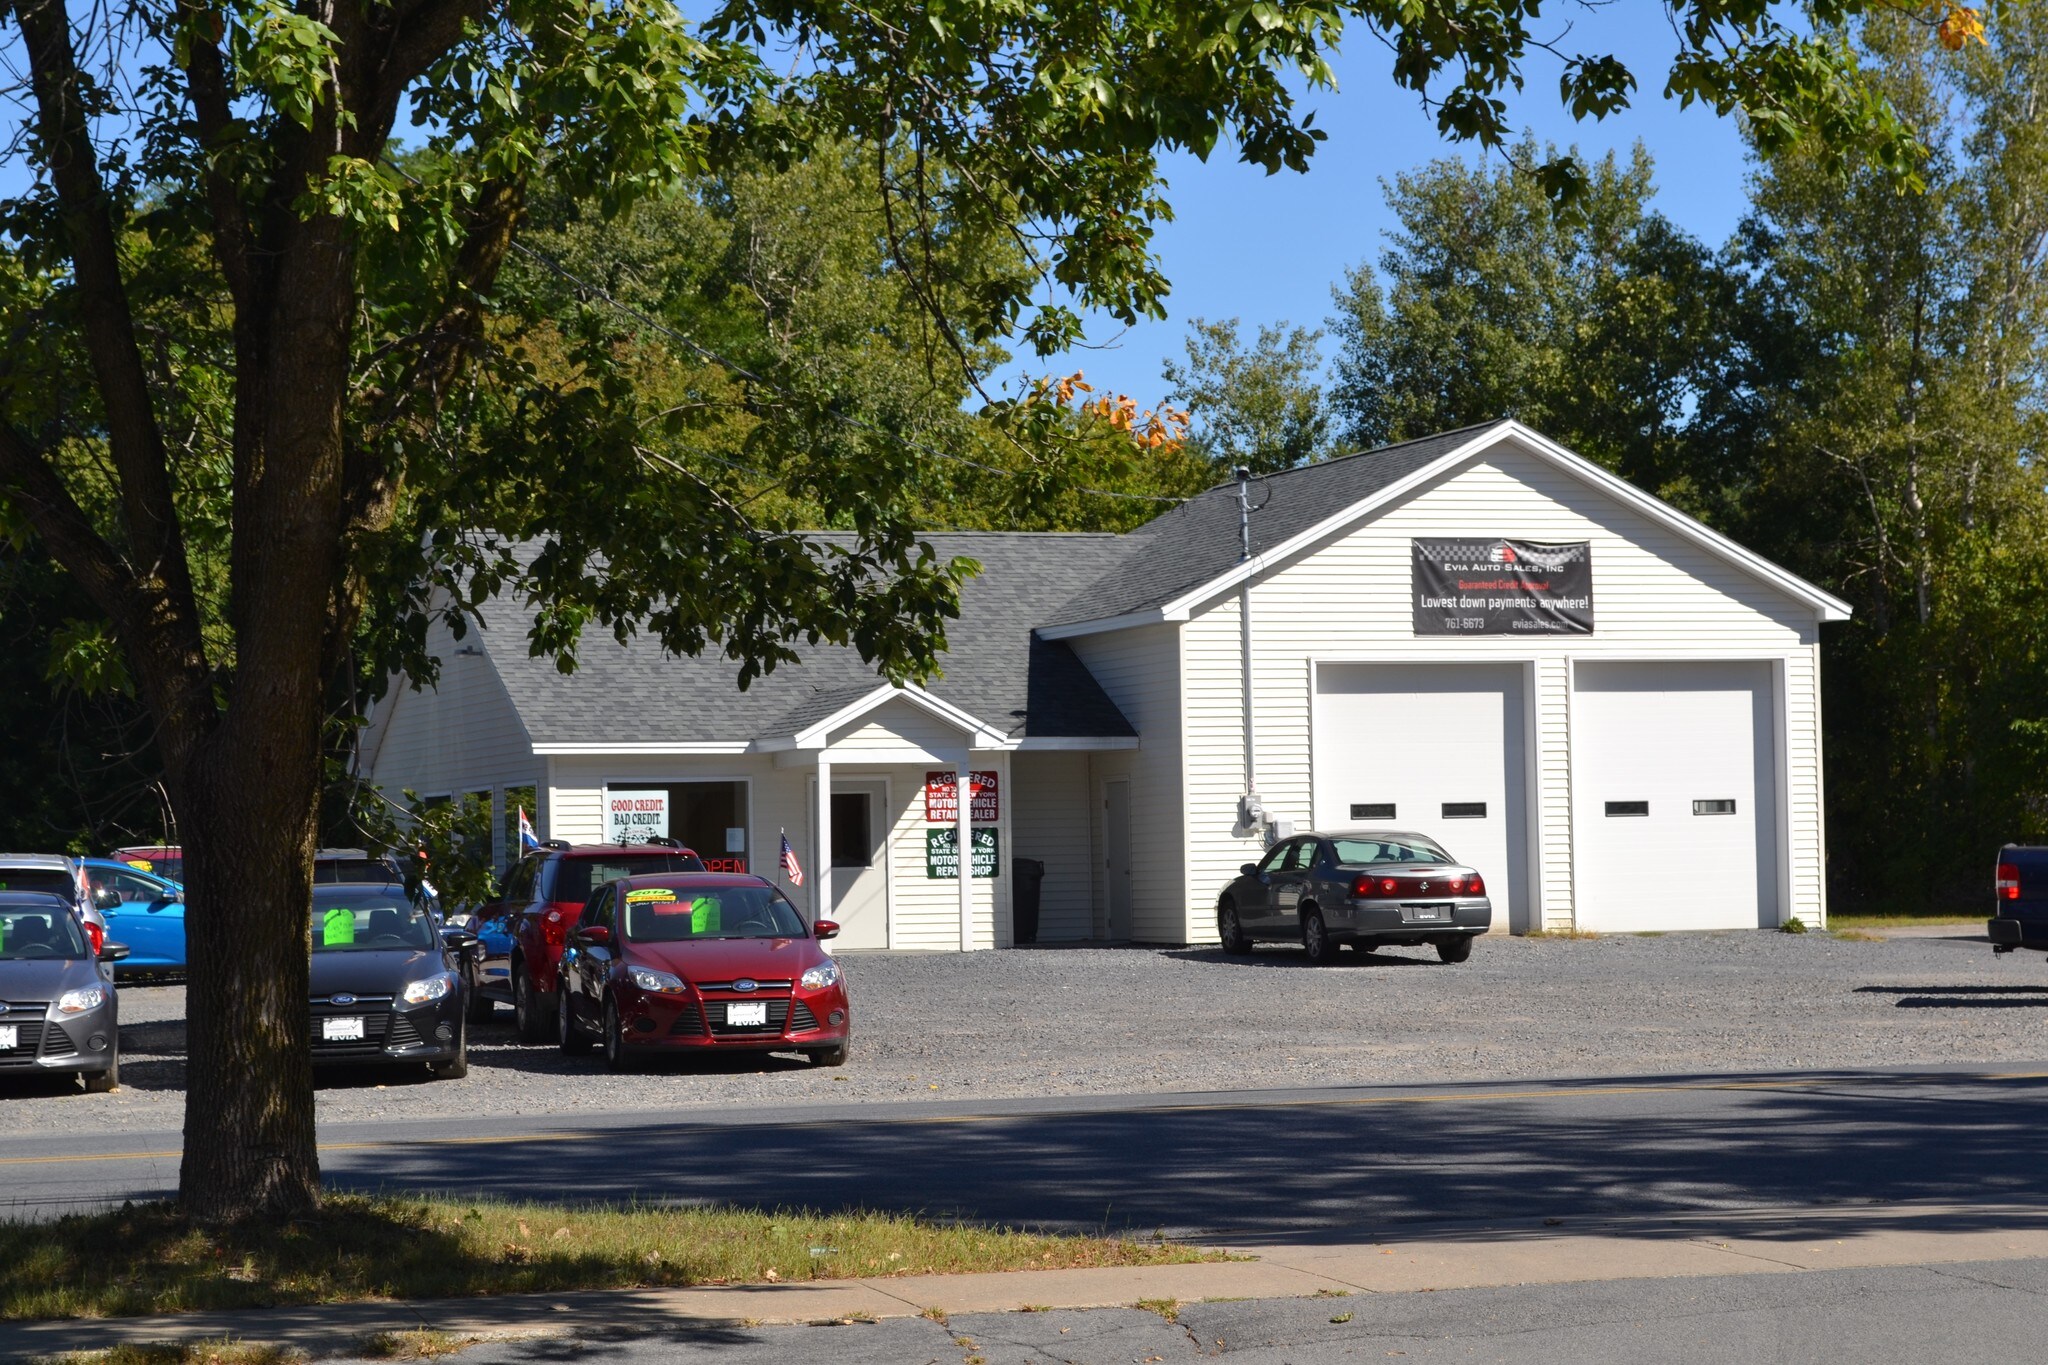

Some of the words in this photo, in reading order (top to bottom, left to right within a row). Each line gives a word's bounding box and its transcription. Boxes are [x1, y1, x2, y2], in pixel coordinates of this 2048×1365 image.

[1458, 580, 1498, 590] Guaranteed
[1498, 580, 1519, 590] Credit
[1421, 594, 1457, 608] Lowest
[1460, 594, 1486, 608] down
[1488, 595, 1537, 610] payments
[1540, 595, 1589, 611] anywhere!
[1445, 618, 1485, 629] 761-6673
[1512, 618, 1569, 629] eviasales.com
[929, 772, 996, 790] REGIERED
[611, 800, 634, 812] GOOD
[634, 799, 664, 812] CREDIT.
[614, 813, 630, 826] BAD
[970, 809, 996, 819] EALER
[930, 830, 995, 848] REGIERED
[701, 859, 746, 874] OPEN
[930, 856, 959, 866] MOTOR
[936, 866, 958, 876] REPA
